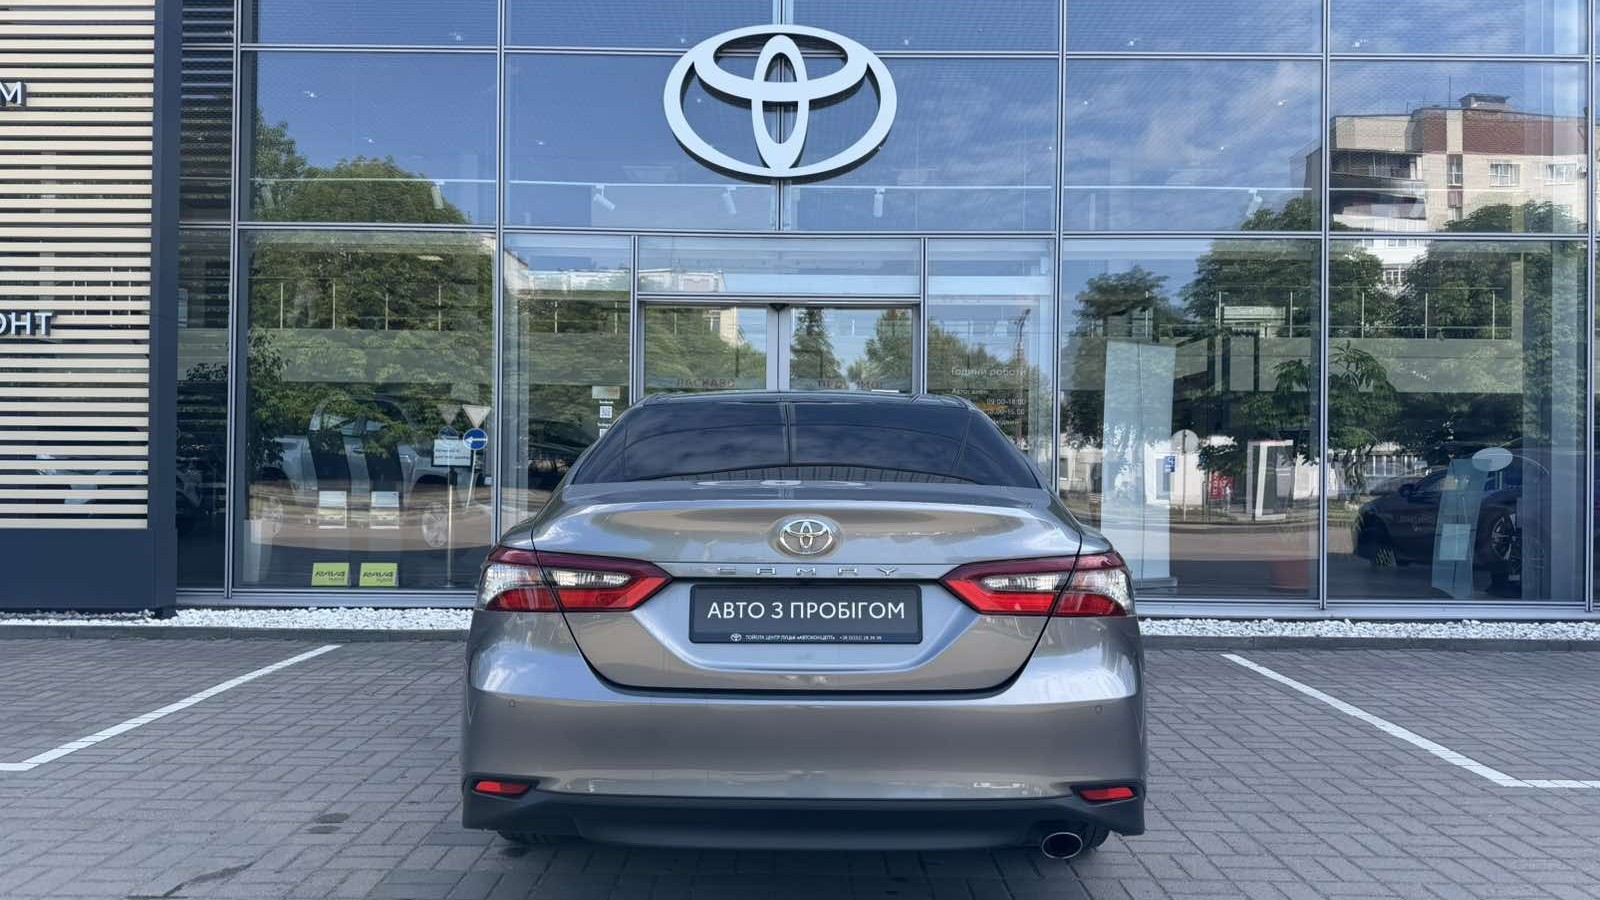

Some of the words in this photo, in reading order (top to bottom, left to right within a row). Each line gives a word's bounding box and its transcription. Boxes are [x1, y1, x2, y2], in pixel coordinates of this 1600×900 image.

[952, 367, 987, 378] Години
[990, 367, 1026, 378] роботи
[716, 566, 898, 577] CAMRY
[707, 602, 765, 619] АВТО
[790, 602, 905, 619] ПРОБІГОМ
